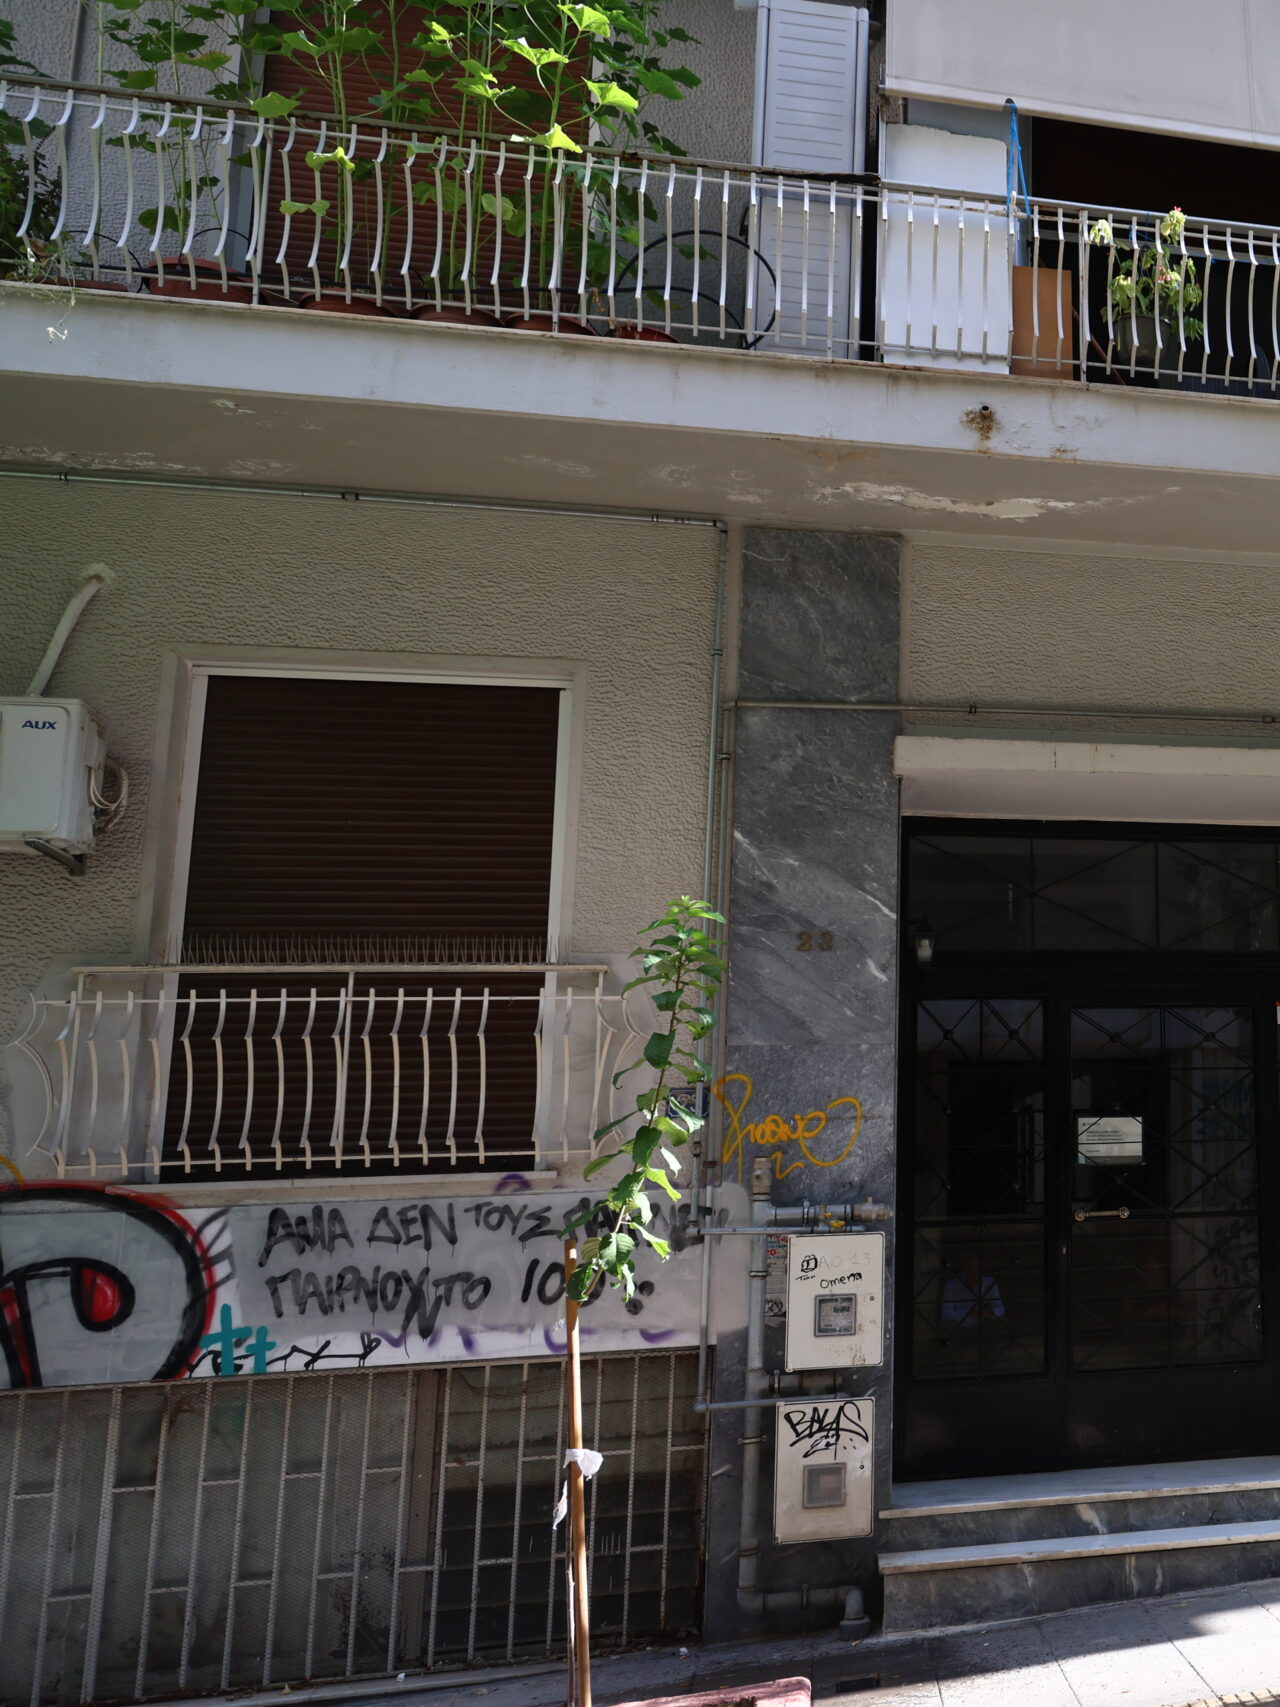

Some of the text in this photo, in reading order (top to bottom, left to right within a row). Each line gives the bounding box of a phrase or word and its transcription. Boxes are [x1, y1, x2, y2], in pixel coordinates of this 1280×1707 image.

[21, 720, 57, 730] AUX
[366, 1202, 459, 1251] ΔΕΝ
[463, 1201, 563, 1243] ΤΟΥΣ
